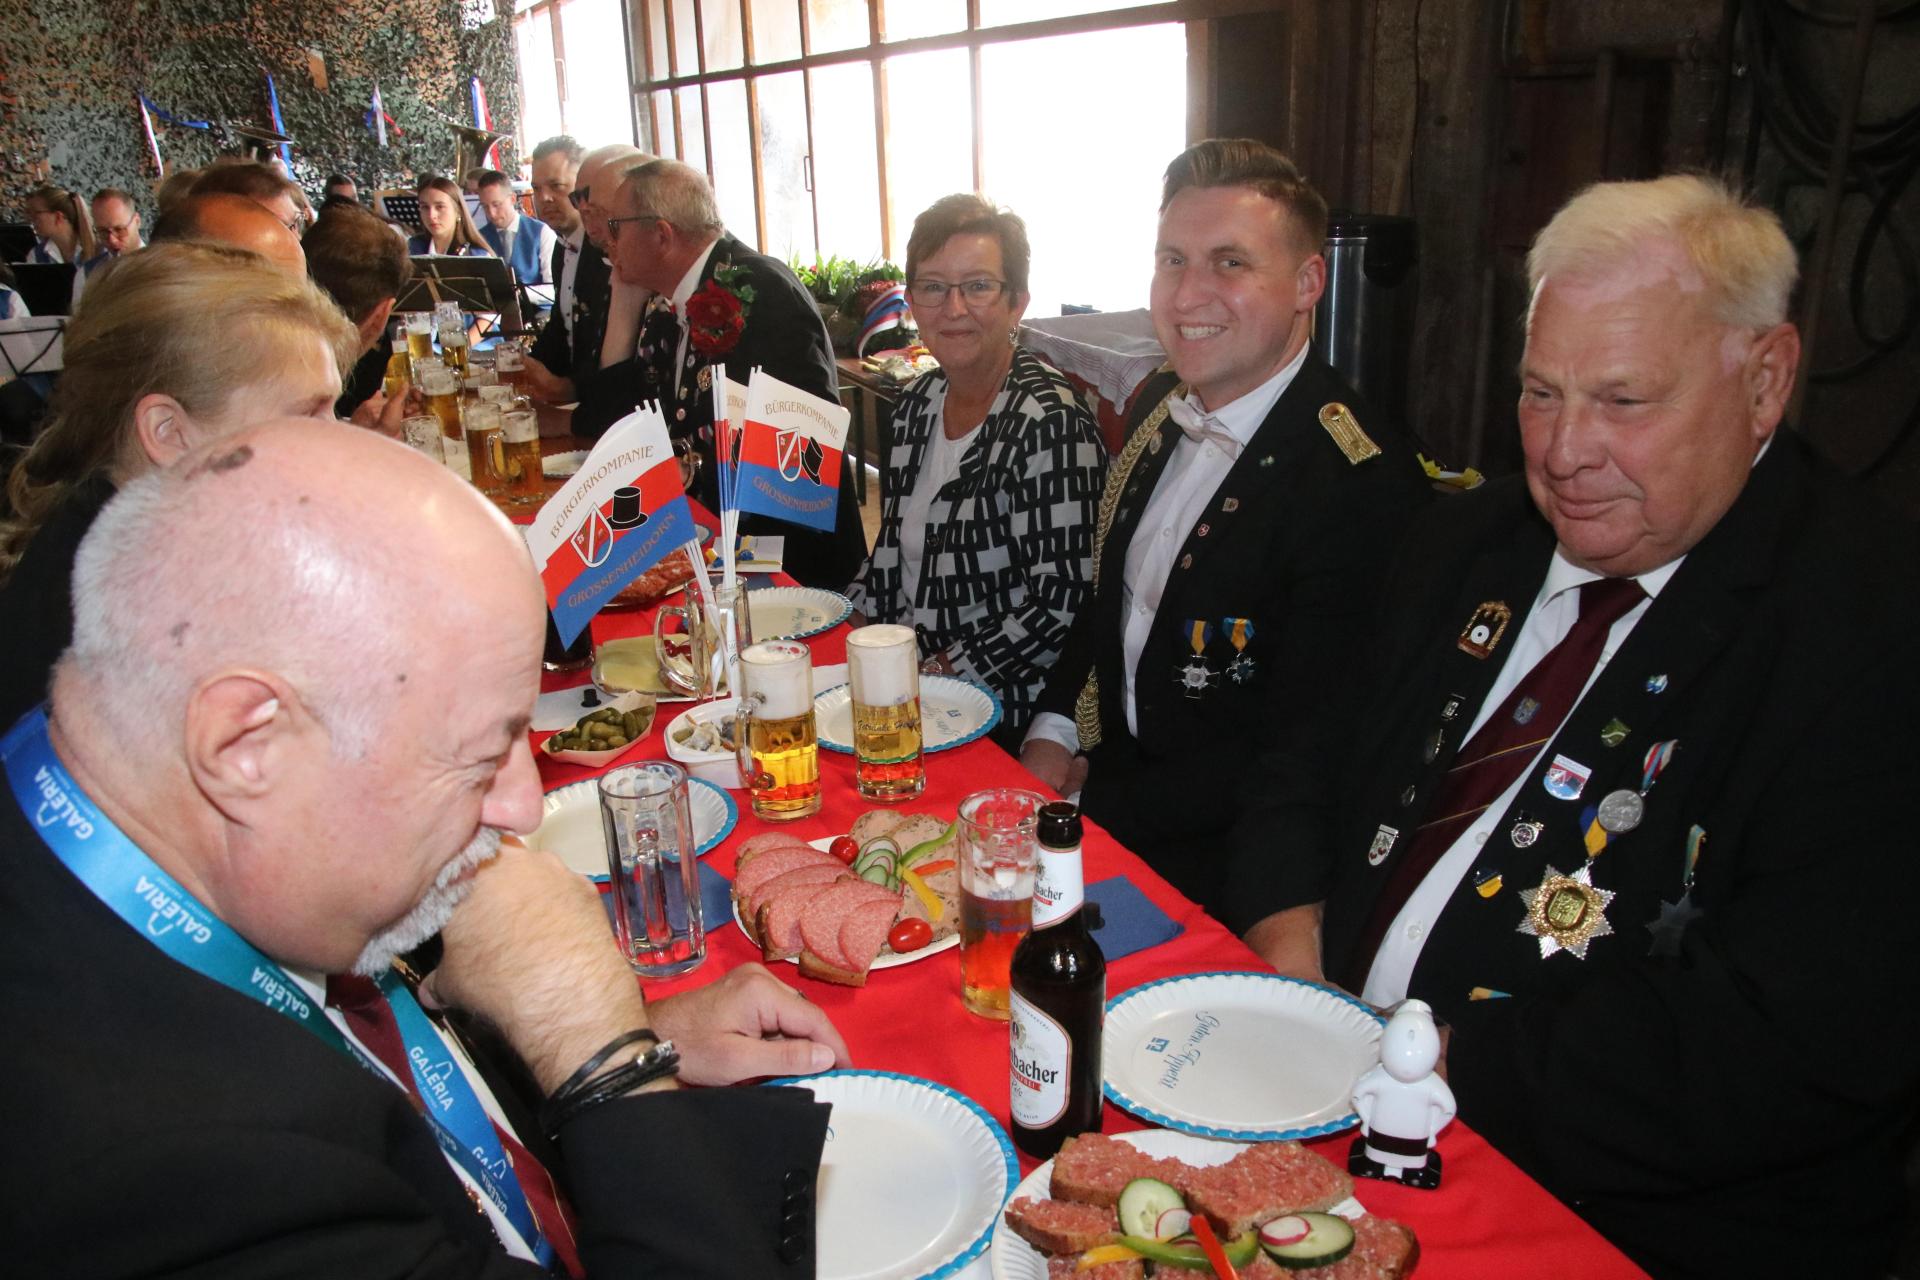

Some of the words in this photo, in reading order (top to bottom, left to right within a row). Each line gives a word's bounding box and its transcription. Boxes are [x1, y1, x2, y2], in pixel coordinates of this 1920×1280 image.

[764, 399, 839, 440] BÜRGERKOMPANIE
[550, 445, 654, 539] BÜRGERKOMPANIE
[568, 512, 676, 608] GROSSENHEIDORN
[34, 765, 95, 840] GALERIA
[135, 875, 212, 944] GALERIA
[1034, 881, 1063, 901] bacher
[251, 966, 310, 1020] GALERIA
[1188, 1010, 1221, 1044] Guten
[410, 1046, 456, 1112] GALERIA
[1158, 1043, 1201, 1090] Appetit
